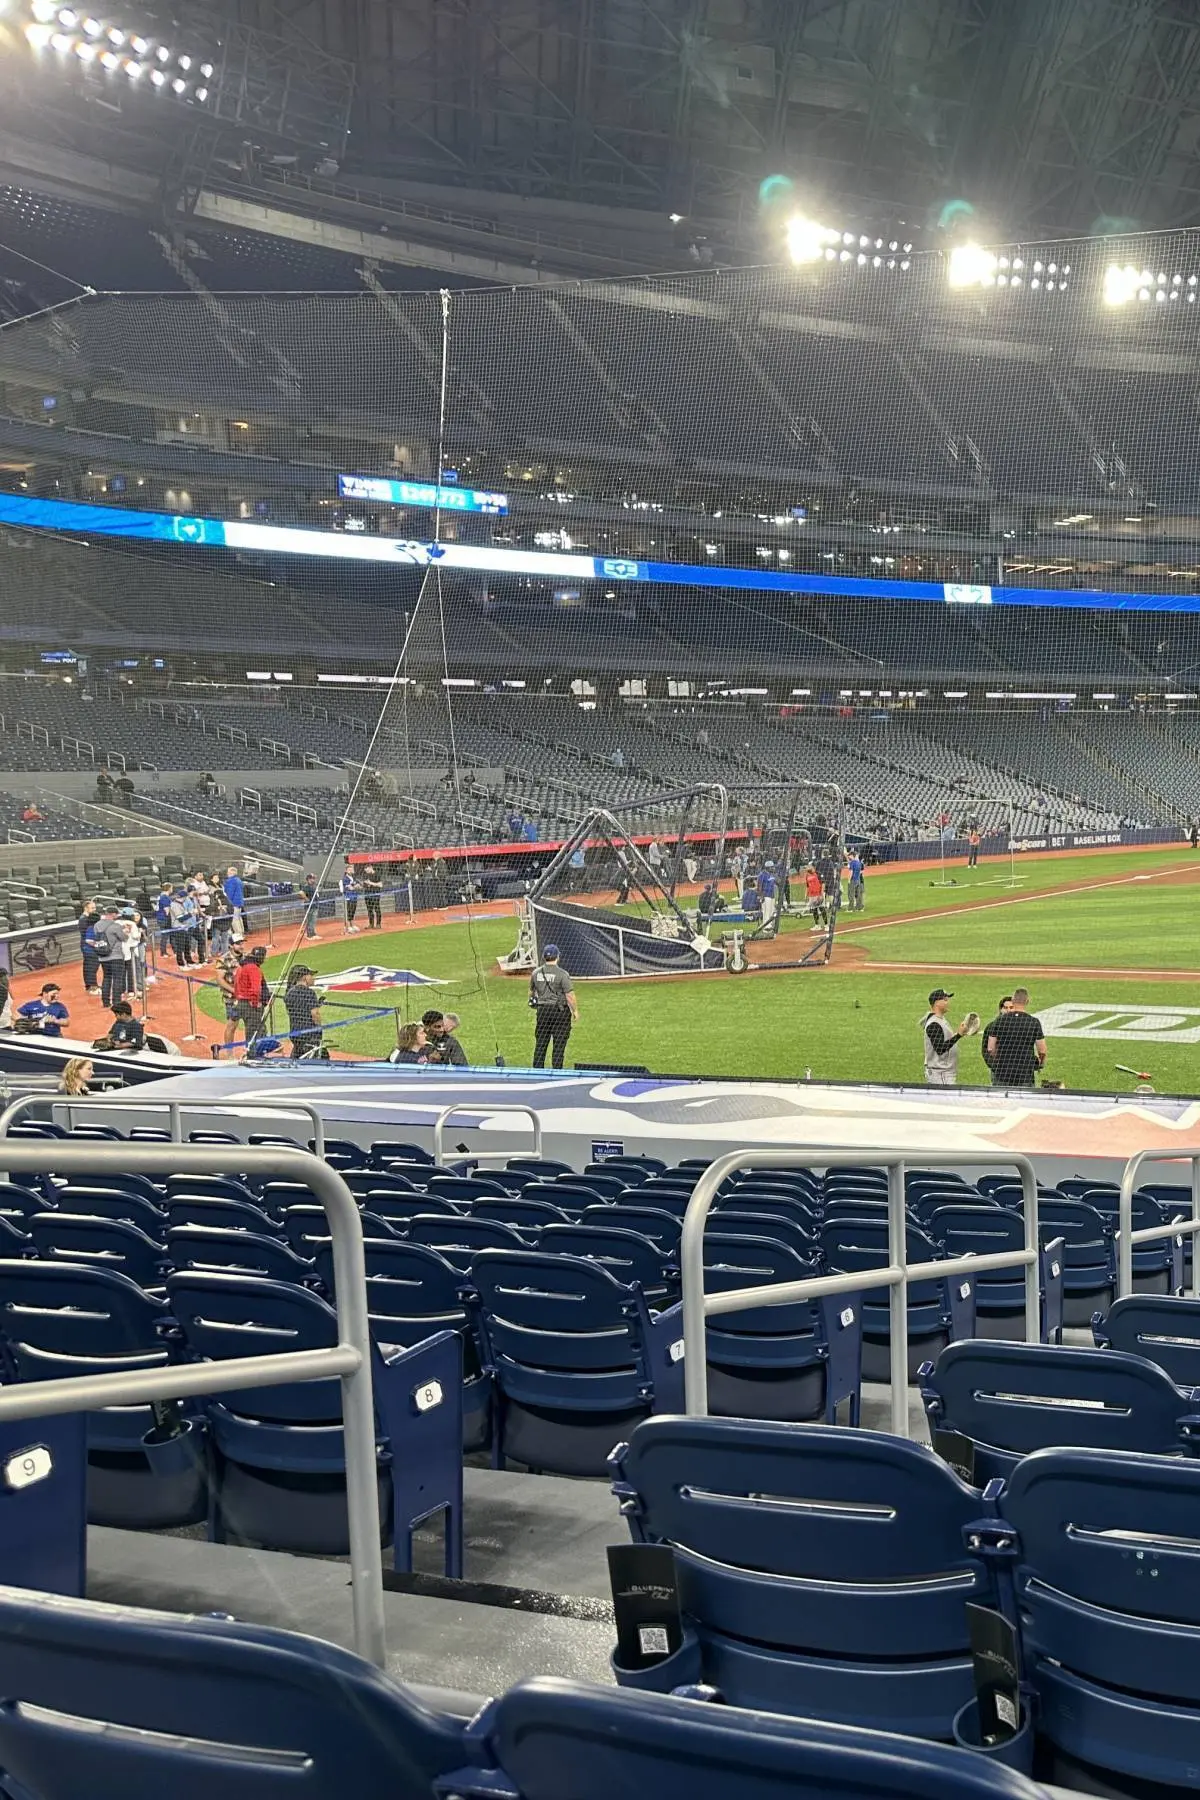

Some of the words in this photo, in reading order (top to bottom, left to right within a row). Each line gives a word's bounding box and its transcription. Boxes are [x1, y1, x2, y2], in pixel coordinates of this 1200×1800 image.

[1051, 837, 1066, 847] BET
[1073, 835, 1106, 845] BASELINE
[1107, 834, 1121, 843] BOX
[424, 1388, 434, 1402] 8
[22, 1458, 37, 1477] 9
[631, 1585, 675, 1594] BLUEPRINT
